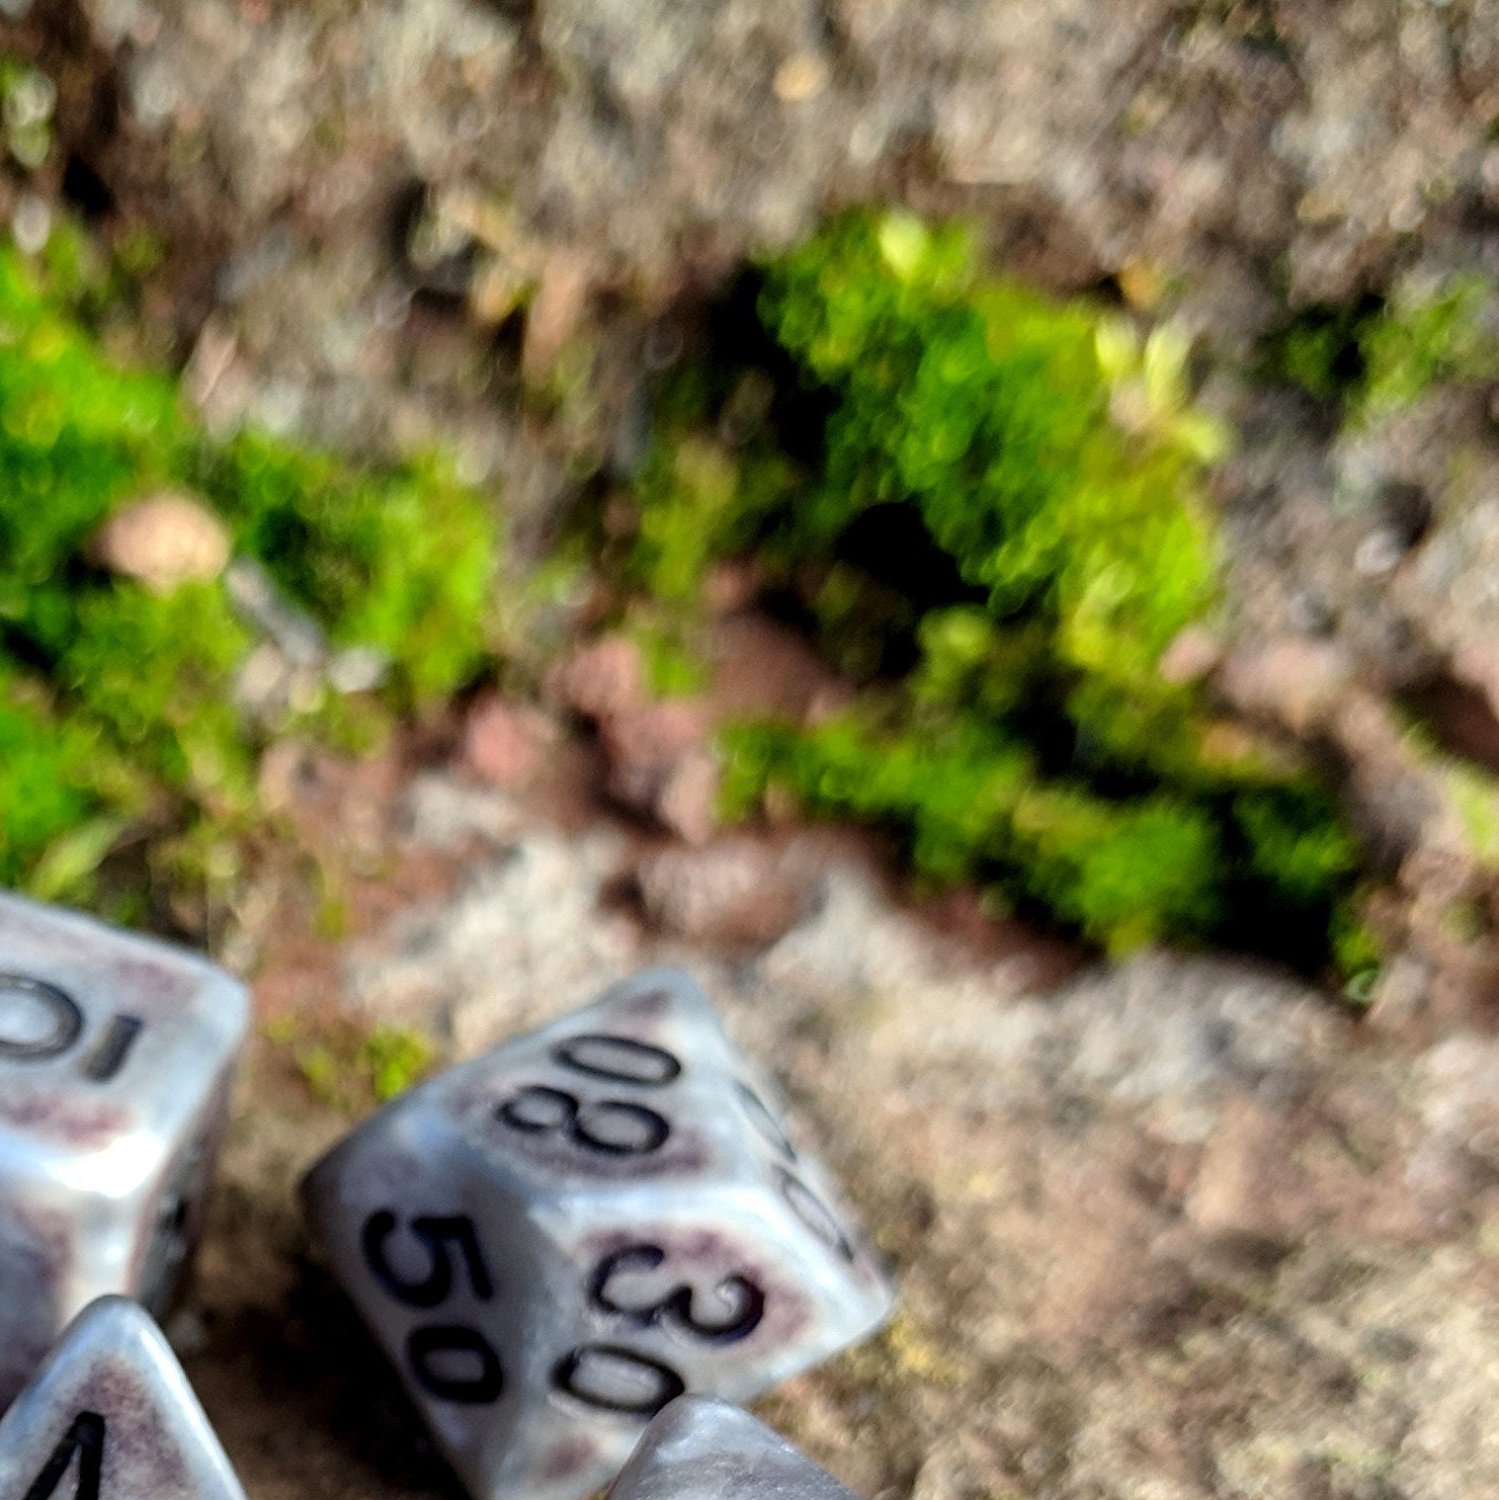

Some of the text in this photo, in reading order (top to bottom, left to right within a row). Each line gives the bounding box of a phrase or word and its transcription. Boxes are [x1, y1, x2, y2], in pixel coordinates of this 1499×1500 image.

[498, 1034, 682, 1158] 80
[361, 1209, 503, 1405] 50
[549, 1243, 766, 1414] 30
